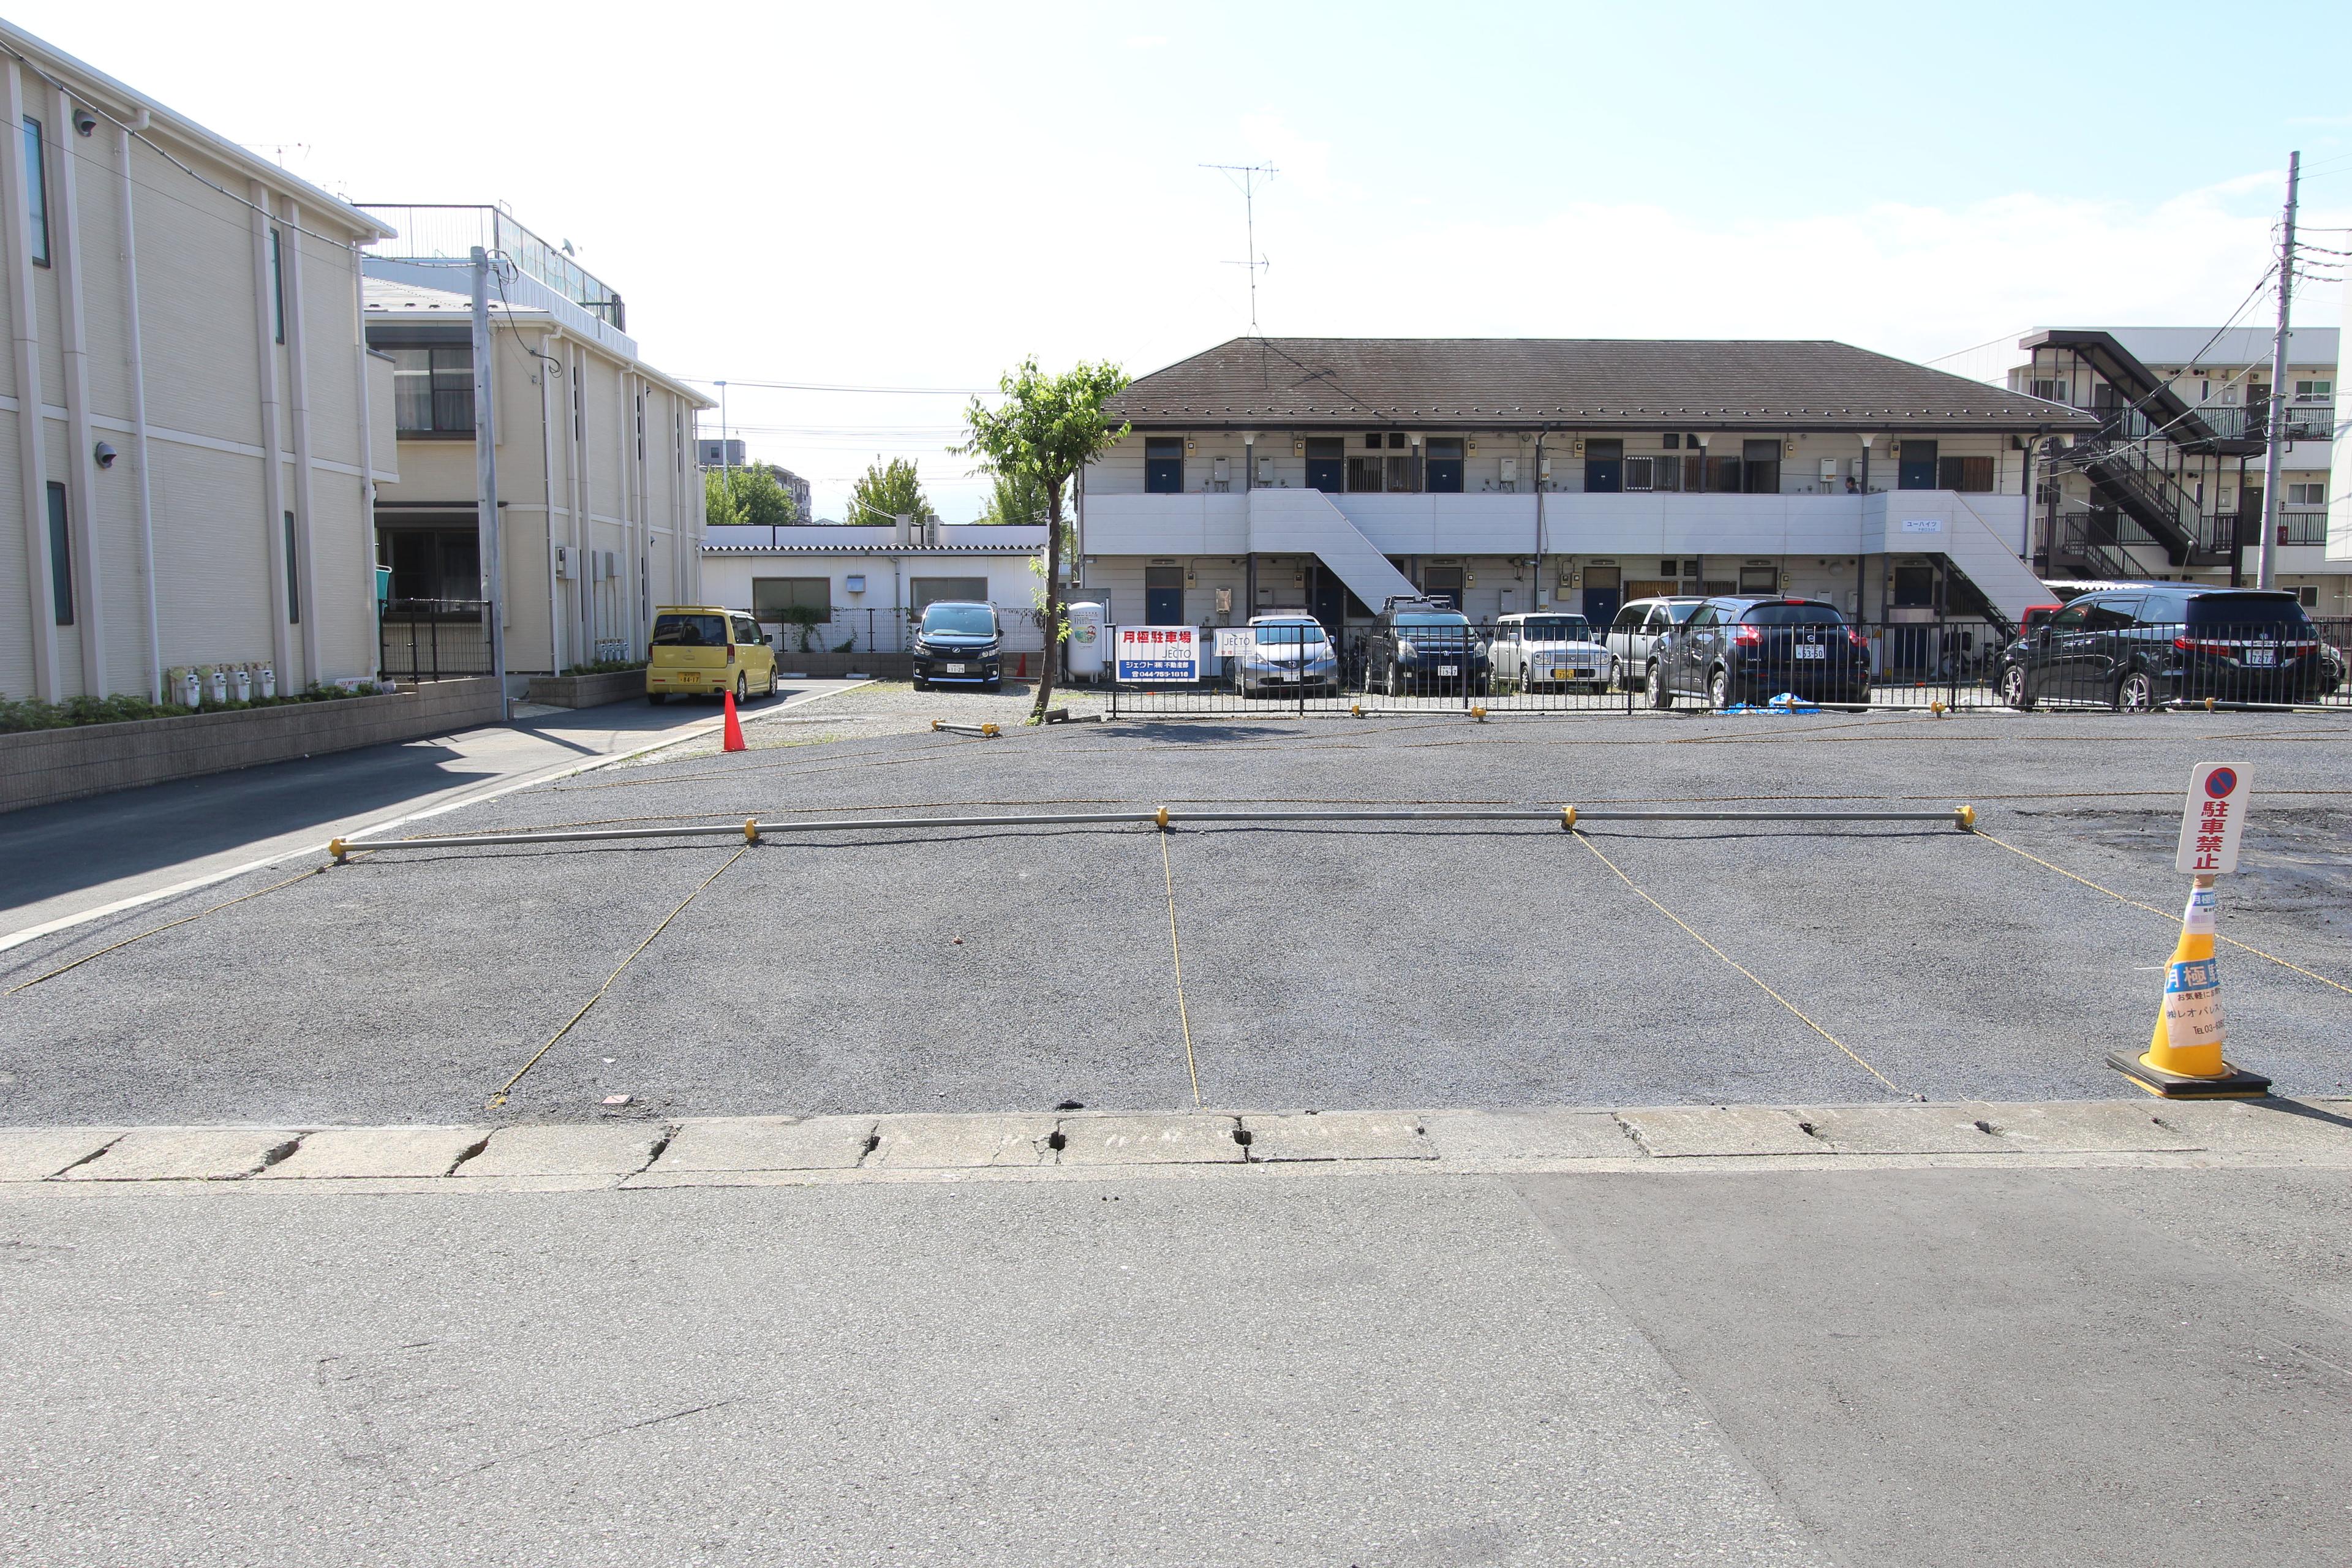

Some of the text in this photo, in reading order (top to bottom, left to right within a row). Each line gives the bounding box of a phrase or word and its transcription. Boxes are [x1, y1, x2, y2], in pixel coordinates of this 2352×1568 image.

[1123, 631, 1191, 643] 月極駐車場
[1224, 637, 1250, 646] JECTO
[1162, 649, 1191, 658] JECTO
[2192, 801, 2230, 870] 駐車禁止
[2192, 894, 2214, 904] 月極
